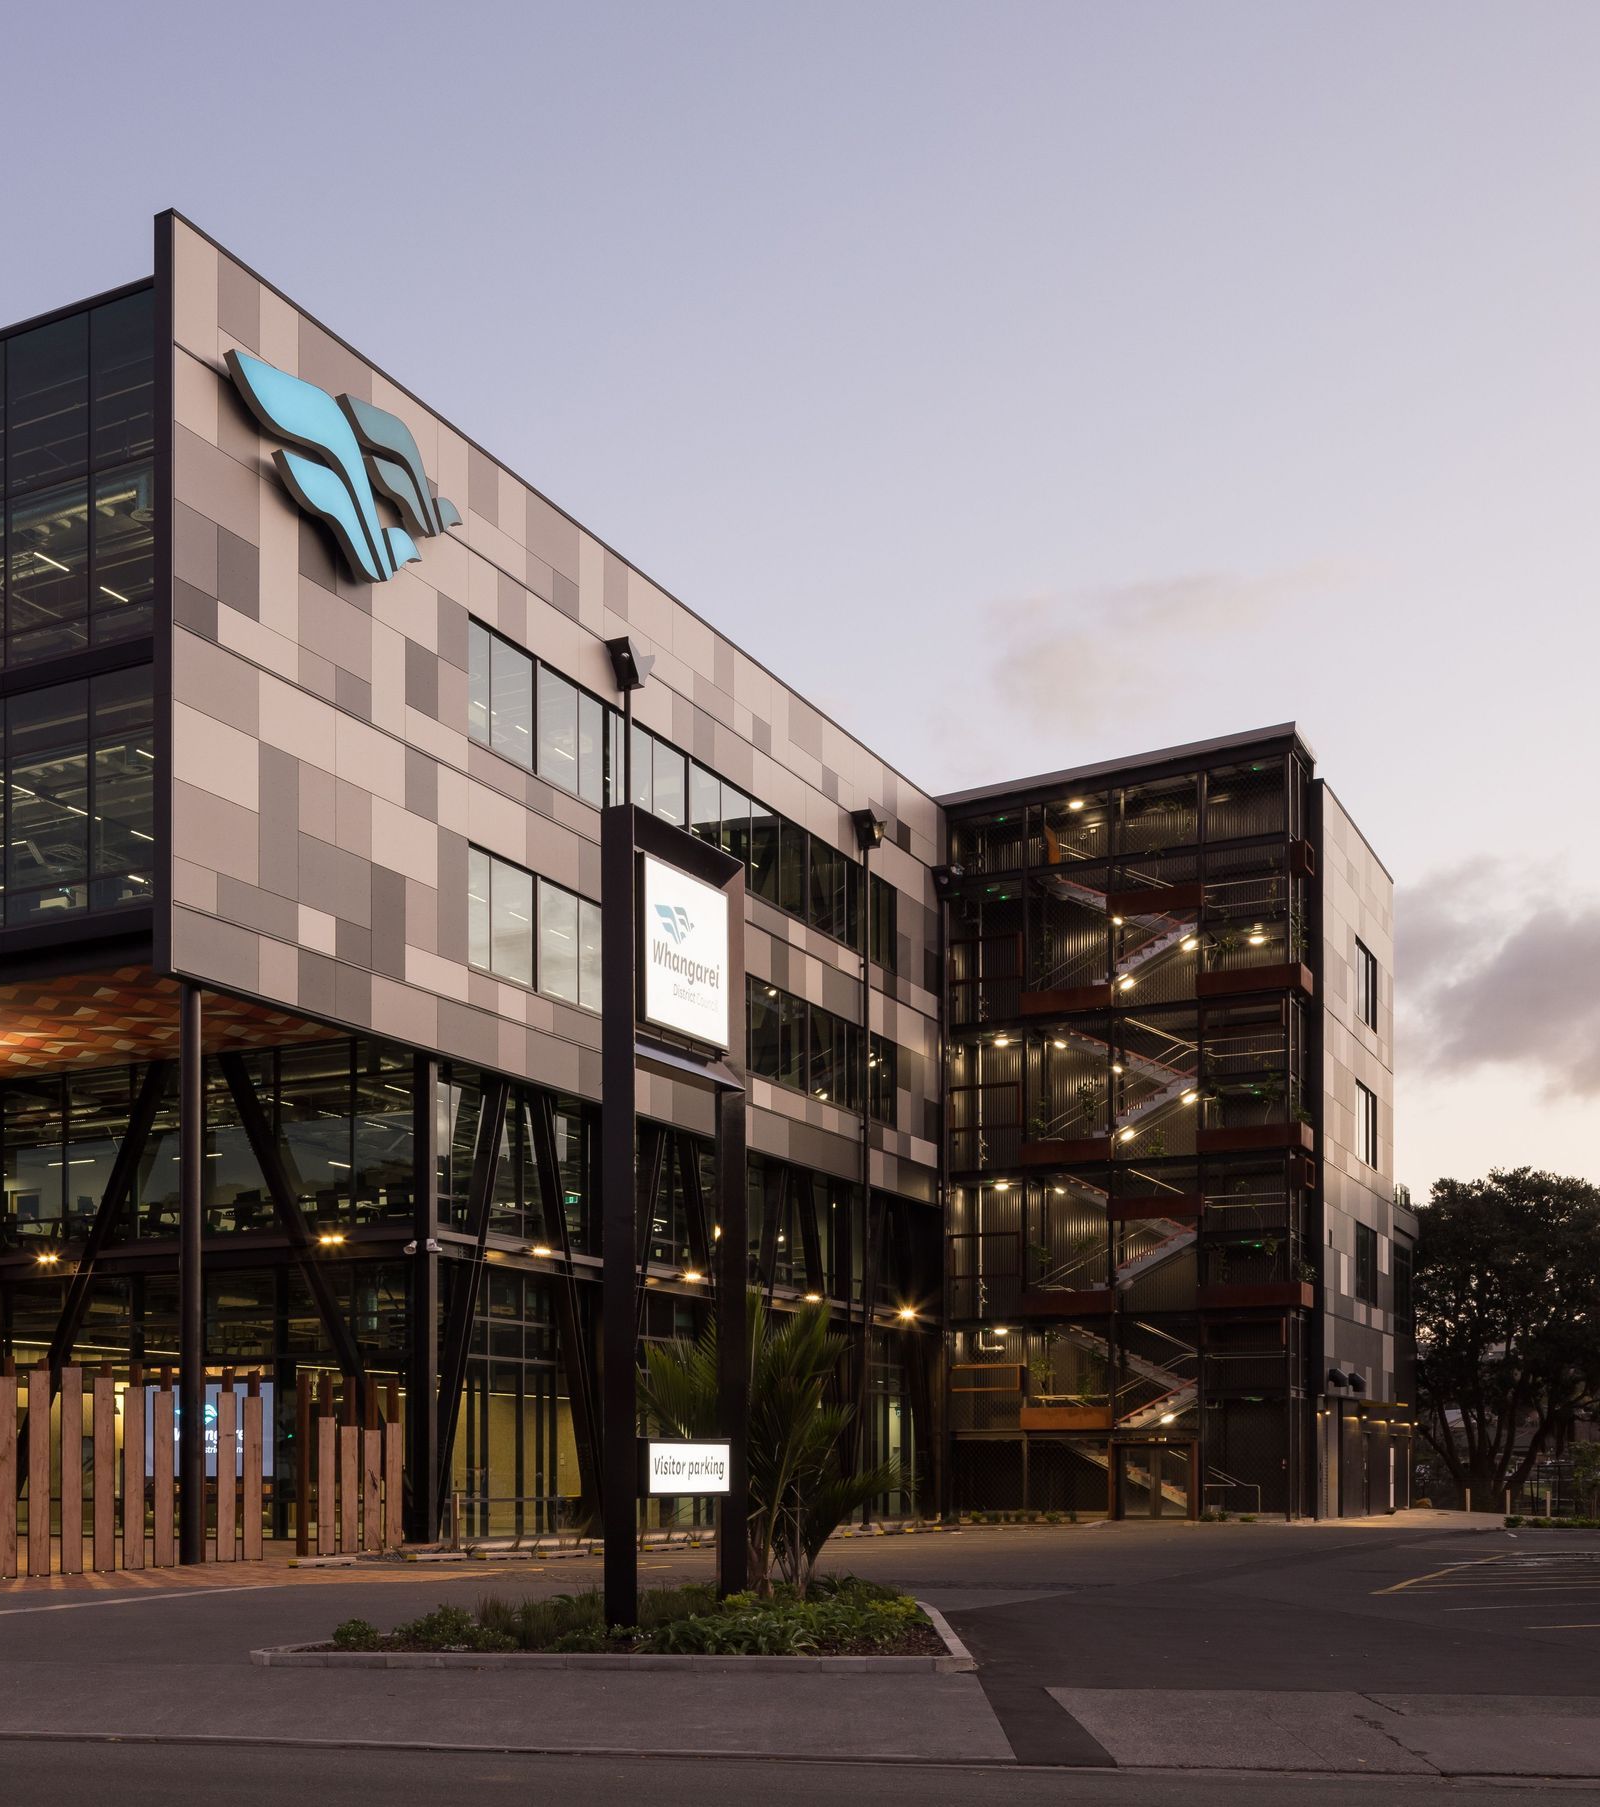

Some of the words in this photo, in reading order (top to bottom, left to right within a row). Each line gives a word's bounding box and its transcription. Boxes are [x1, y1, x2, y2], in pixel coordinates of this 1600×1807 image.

[653, 939, 720, 990] Whangarei
[673, 983, 696, 1004] District
[654, 1455, 686, 1475] Visitor
[688, 1456, 724, 1480] parking
